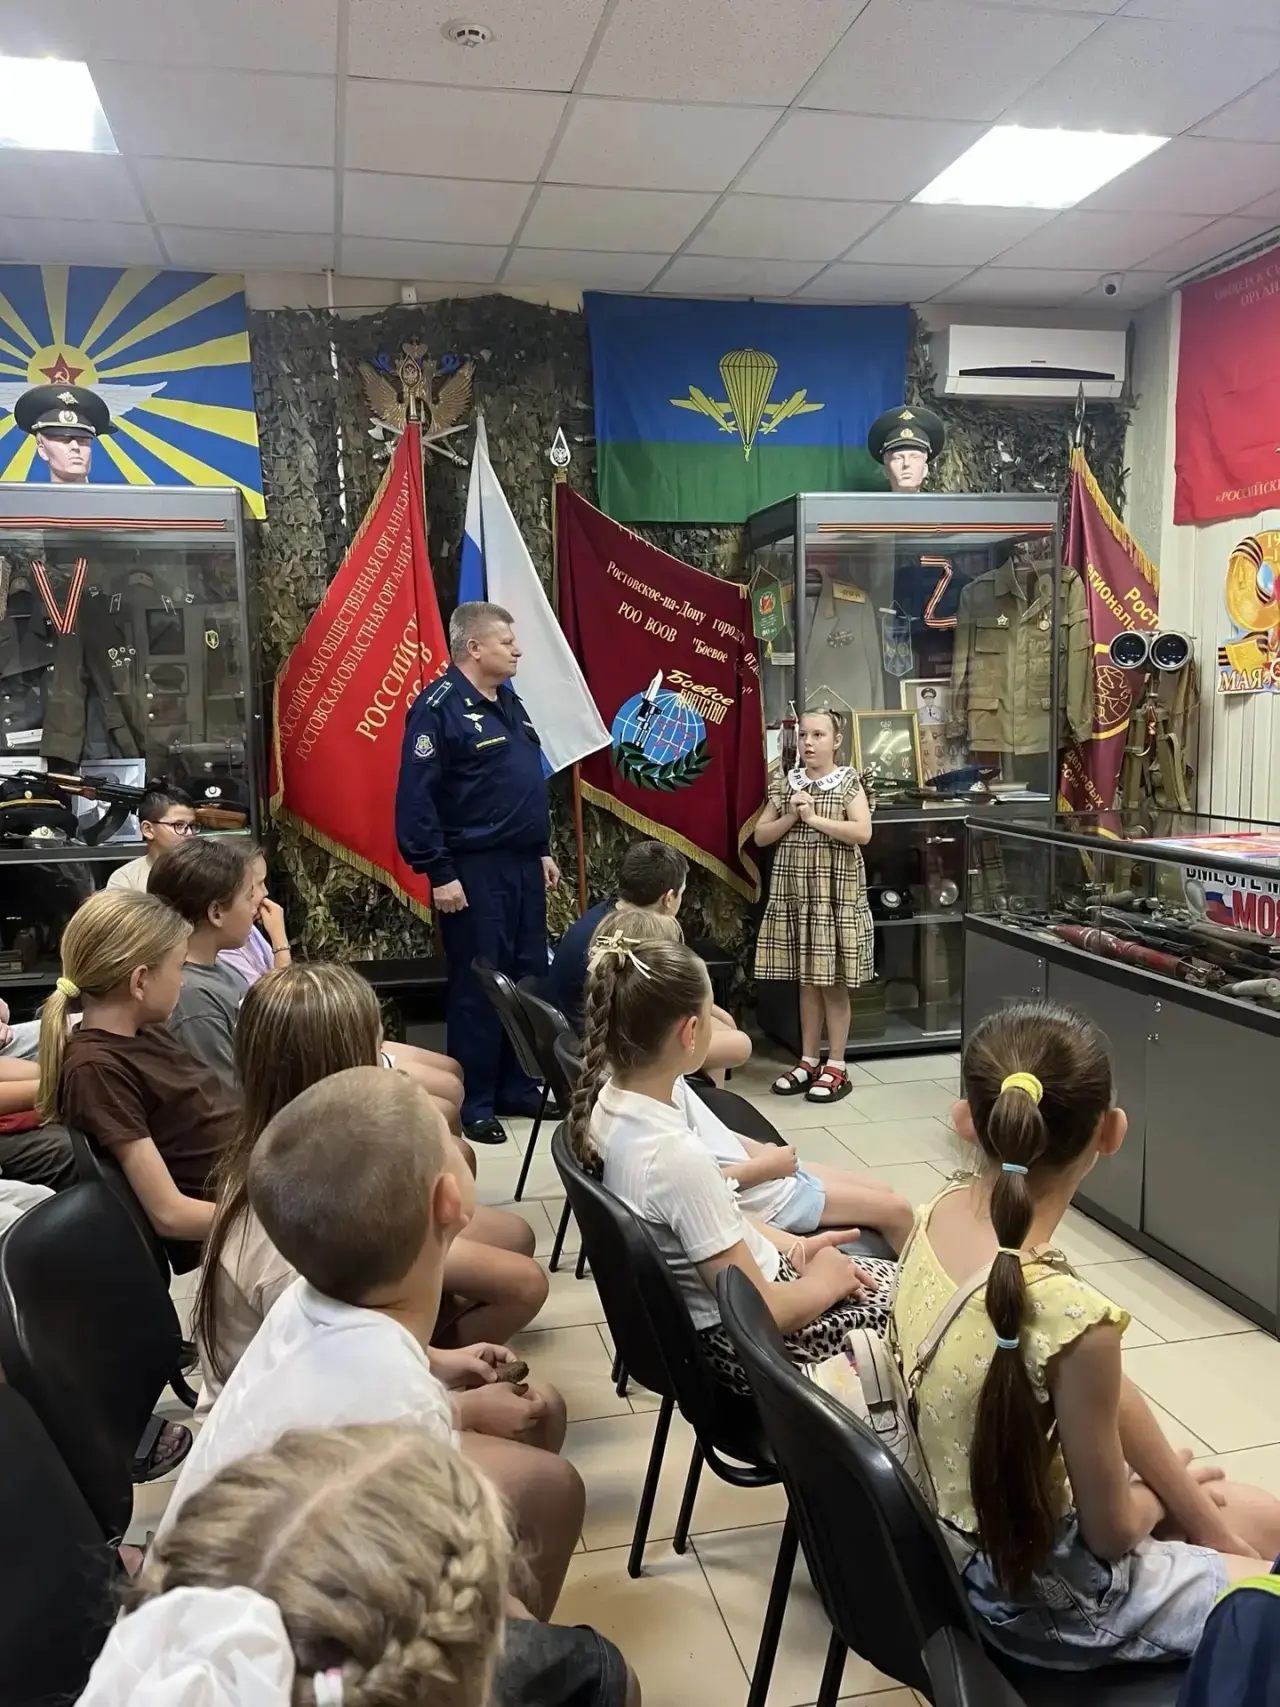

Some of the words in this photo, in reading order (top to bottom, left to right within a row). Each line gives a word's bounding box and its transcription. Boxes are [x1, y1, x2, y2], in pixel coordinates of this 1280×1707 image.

[318, 556, 384, 661] ОБЩЕСТВЕННАЯ
[606, 560, 707, 627] Ростовское-на-Дону
[617, 601, 643, 624] РОО
[644, 616, 678, 643] ВООВ
[295, 675, 345, 761] РОСТОВСКАЯ
[336, 602, 389, 680] ОБЛАСТНАЯ
[666, 669, 735, 706] Боевое
[1218, 667, 1265, 692] МАЯ
